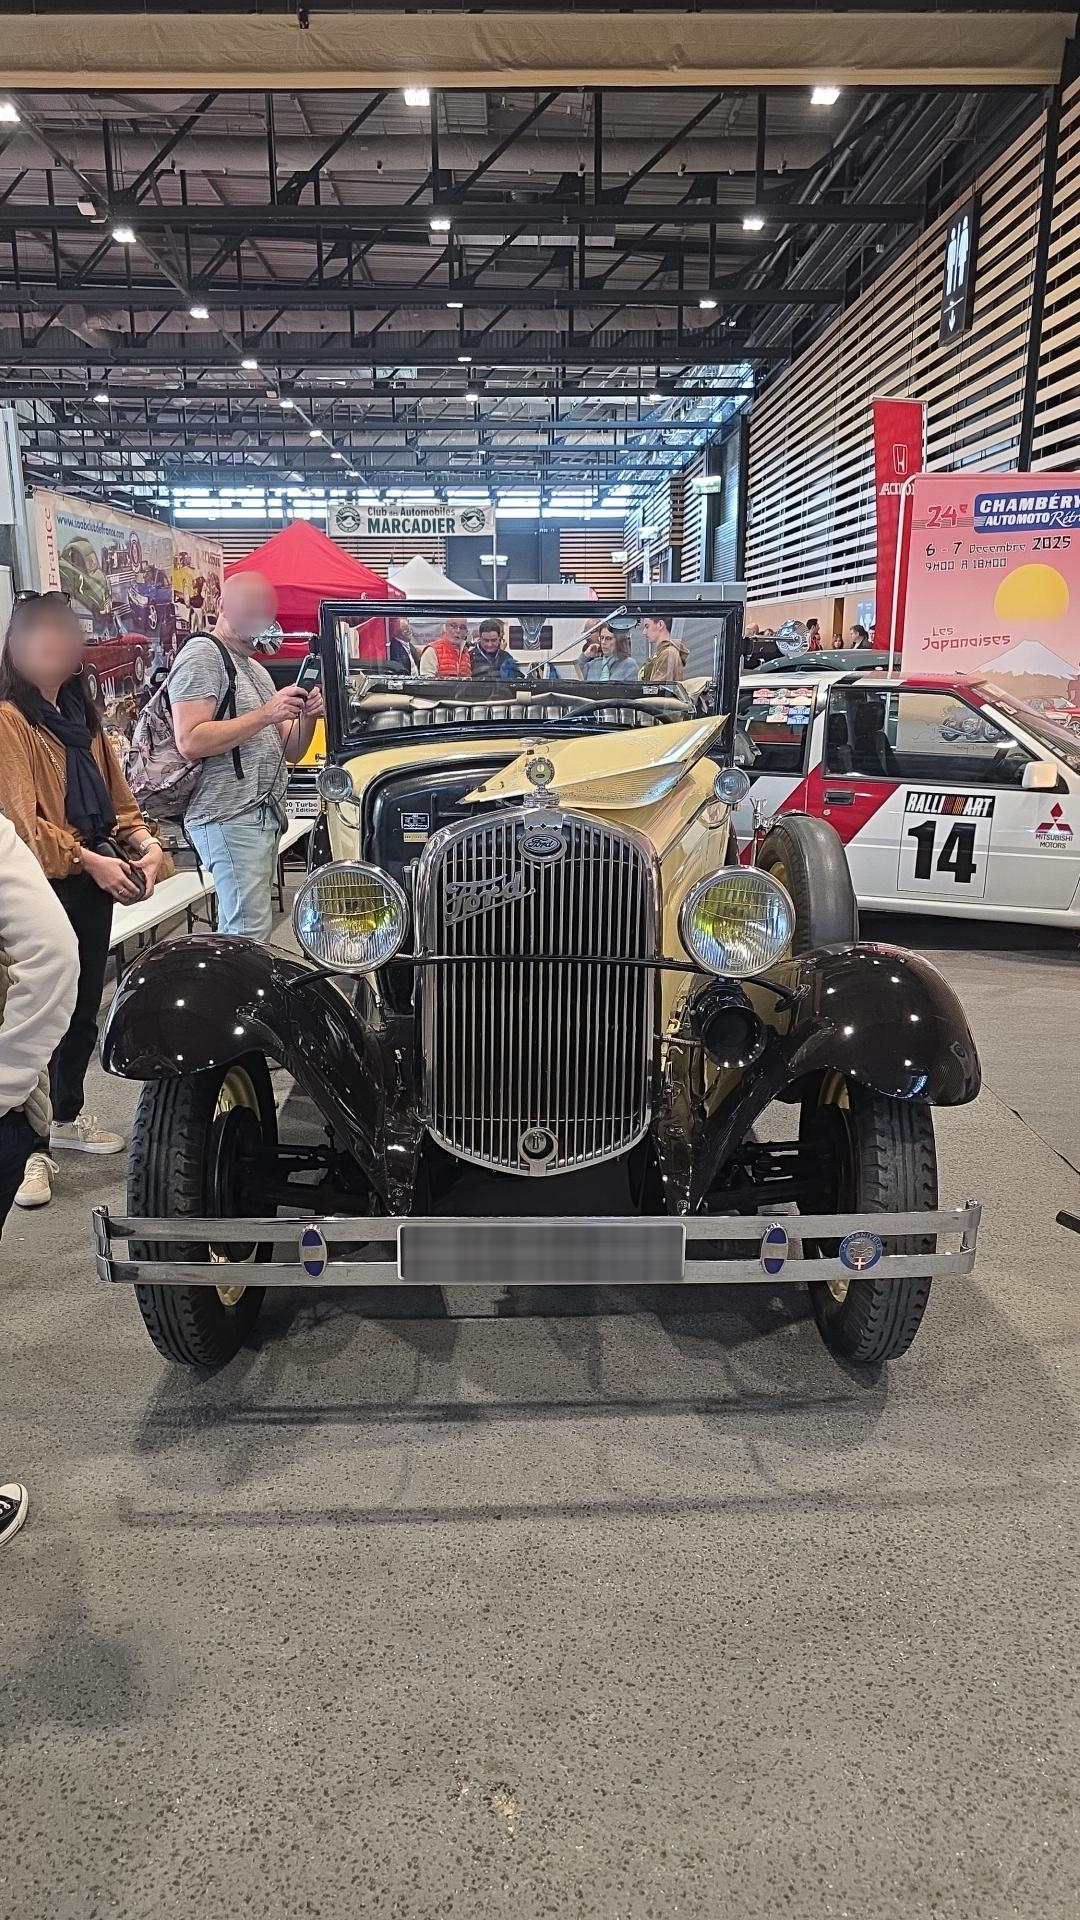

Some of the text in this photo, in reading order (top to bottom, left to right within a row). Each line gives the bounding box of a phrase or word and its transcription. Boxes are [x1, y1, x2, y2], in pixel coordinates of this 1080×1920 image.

[367, 507, 387, 517] Club
[400, 507, 456, 517] Automobiles
[367, 518, 456, 534] MARCADIER
[45, 507, 58, 587] France
[926, 543, 936, 557] 6
[953, 541, 963, 555] 7
[1032, 536, 1071, 551] 2025
[932, 626, 954, 637] Les
[922, 634, 1011, 652] Japonaises
[906, 793, 946, 813] RALLI
[528, 838, 554, 848] Ford
[1035, 834, 1073, 842] MITSUBISHI
[908, 820, 977, 883] 14
[446, 873, 536, 924] Ford
